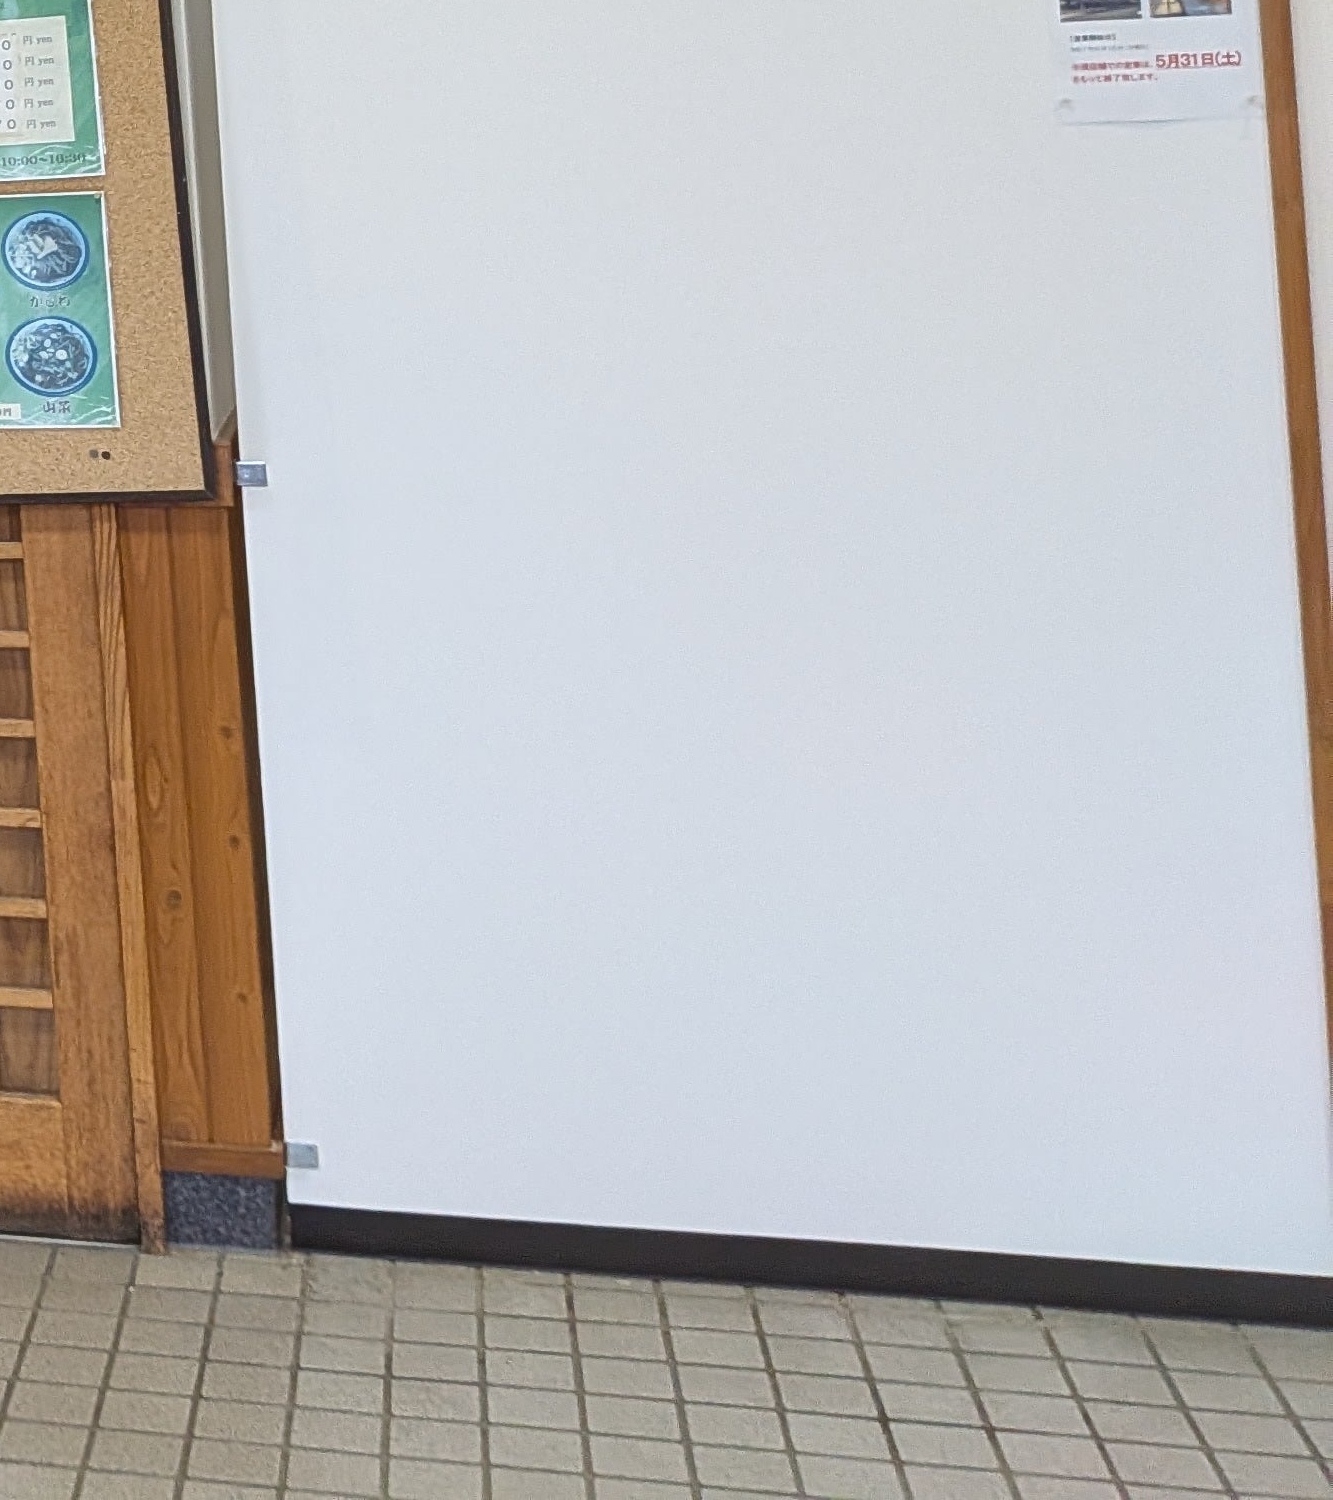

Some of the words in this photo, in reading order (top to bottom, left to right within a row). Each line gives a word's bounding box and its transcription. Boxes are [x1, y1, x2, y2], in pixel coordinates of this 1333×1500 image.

[22, 35, 33, 45] 円
[35, 35, 53, 46] yen
[24, 56, 35, 66] 円
[37, 56, 55, 67] yen
[24, 77, 35, 87] 円
[37, 77, 55, 87] yen
[23, 98, 34, 108] 円
[36, 98, 54, 109] yen
[26, 119, 37, 129] 円
[39, 119, 57, 129] yen
